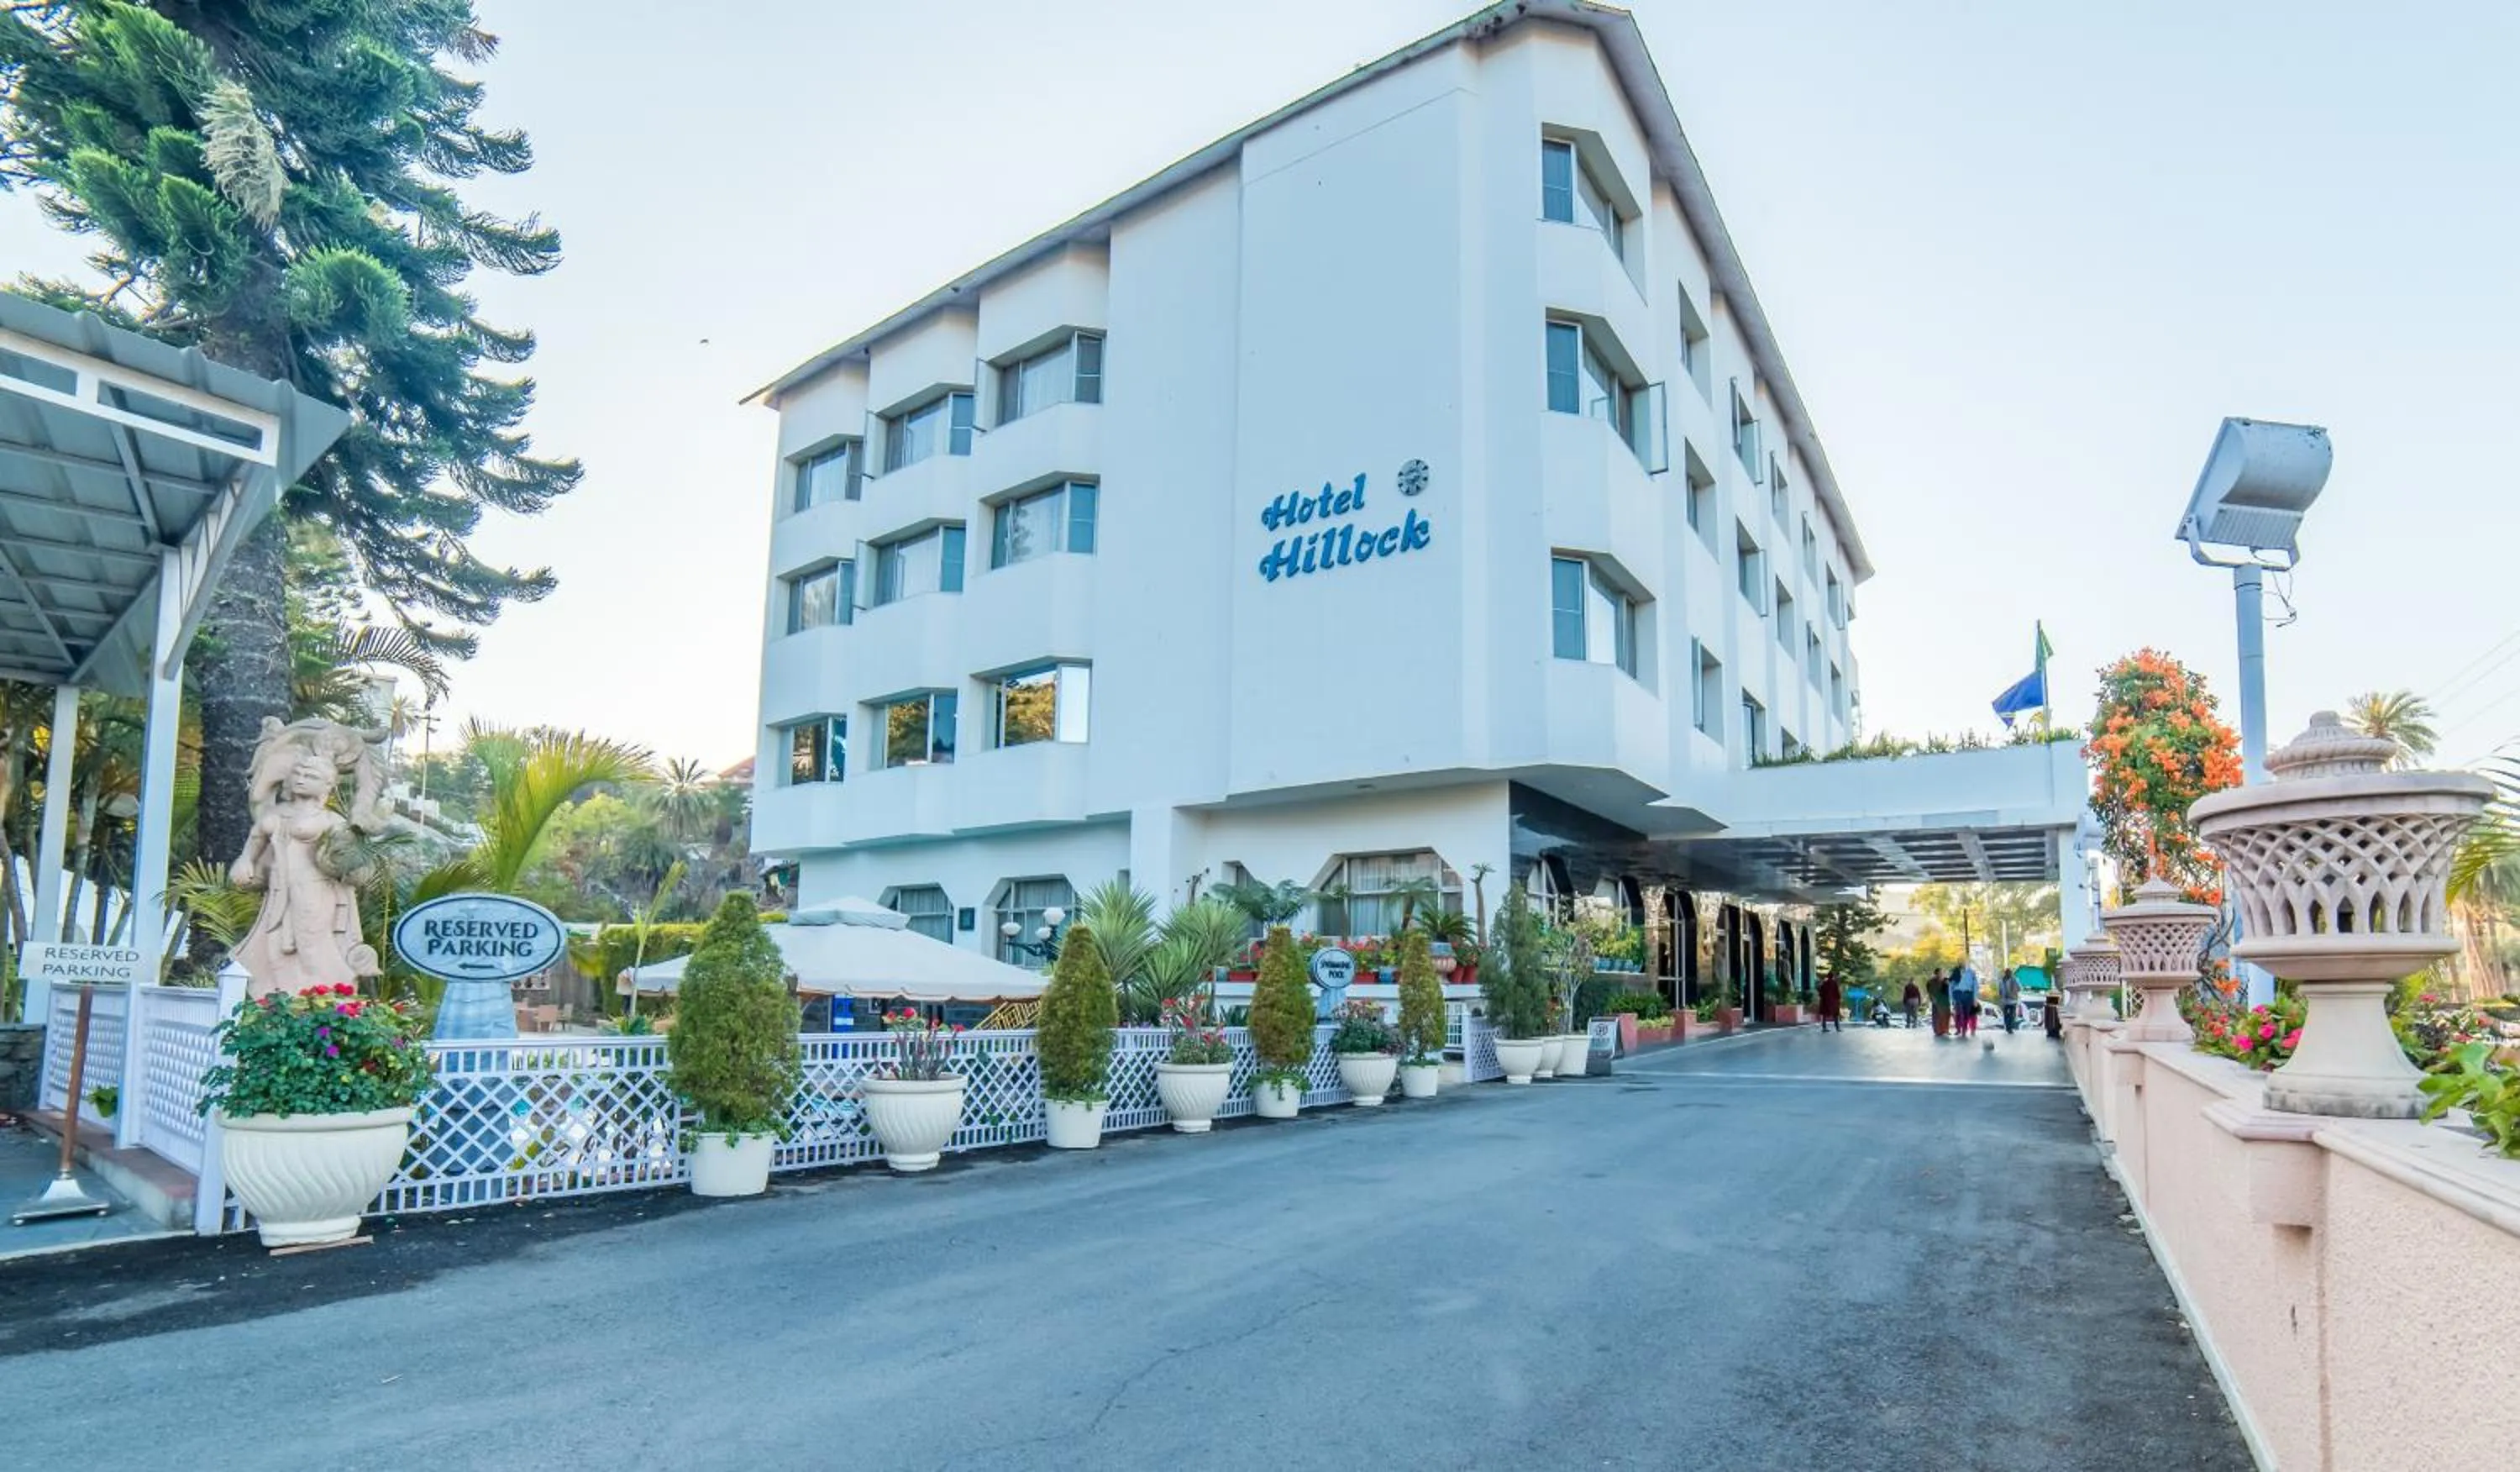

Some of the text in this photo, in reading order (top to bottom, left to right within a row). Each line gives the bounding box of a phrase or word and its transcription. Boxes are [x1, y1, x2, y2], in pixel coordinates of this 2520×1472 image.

[1261, 472, 1366, 532] Hotel
[1259, 507, 1431, 582] Hillock
[424, 919, 538, 939] RESERVED
[45, 947, 139, 962] RESERVED
[428, 938, 533, 957] PARKING
[42, 964, 130, 978] PARKING
